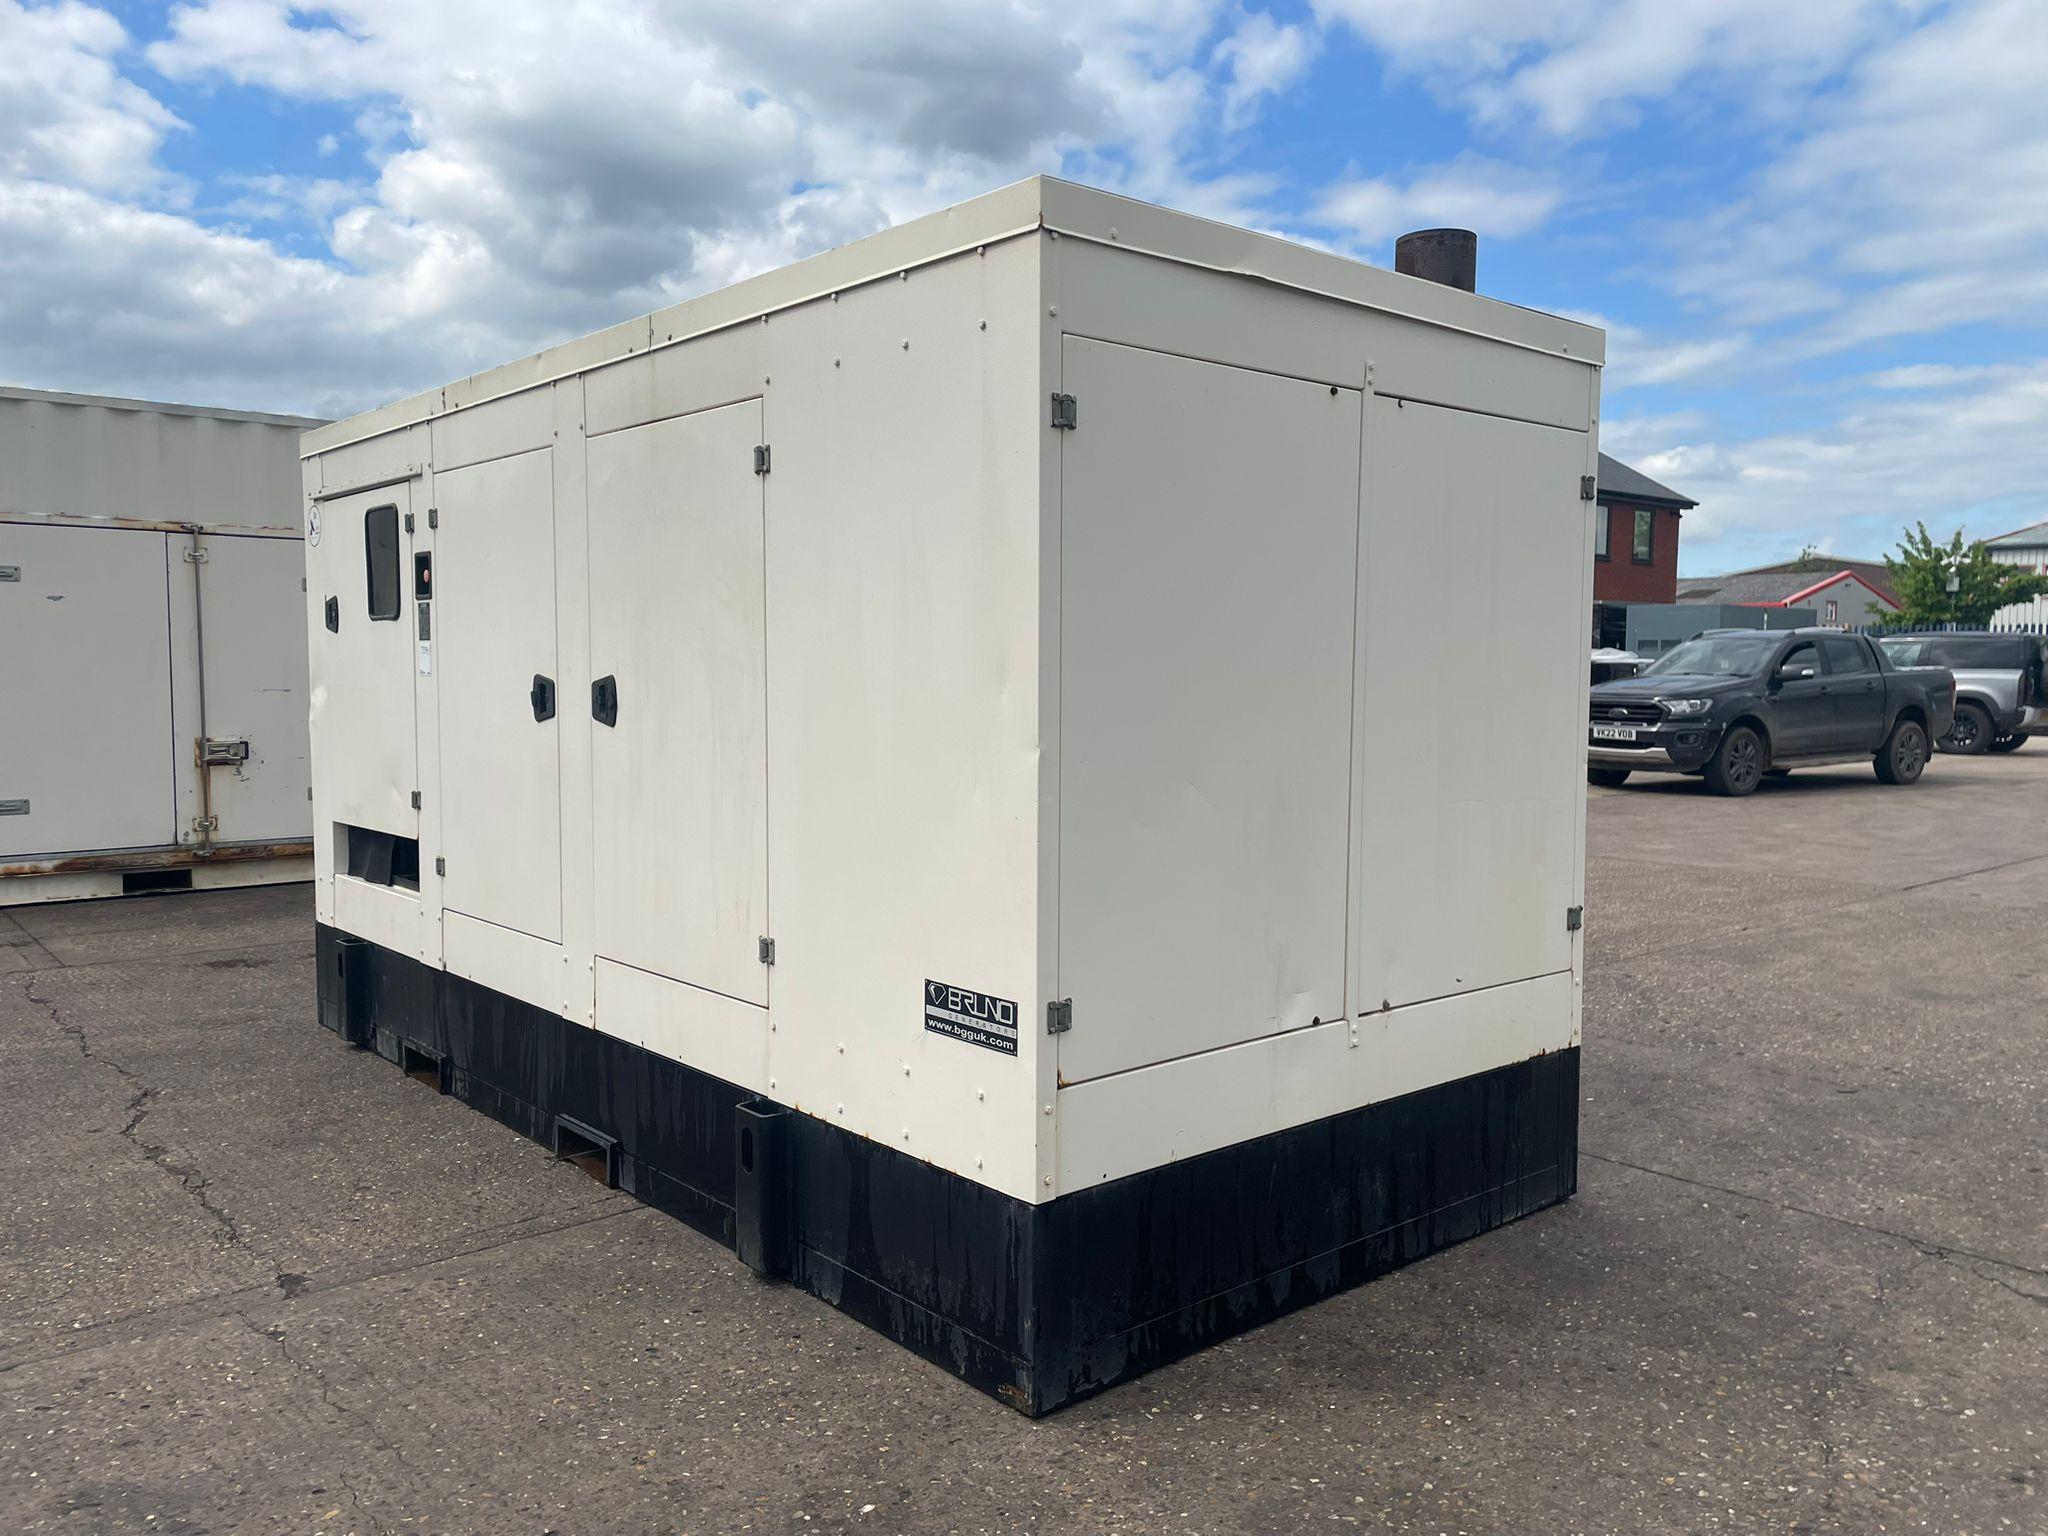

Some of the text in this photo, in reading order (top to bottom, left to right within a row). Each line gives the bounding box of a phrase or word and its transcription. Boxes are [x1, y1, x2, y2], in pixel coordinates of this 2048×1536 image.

[948, 987, 1013, 1025] BRUNO
[927, 1018, 1014, 1050] www.bgguk.com
[948, 1012, 1016, 1037] GENERATORS
